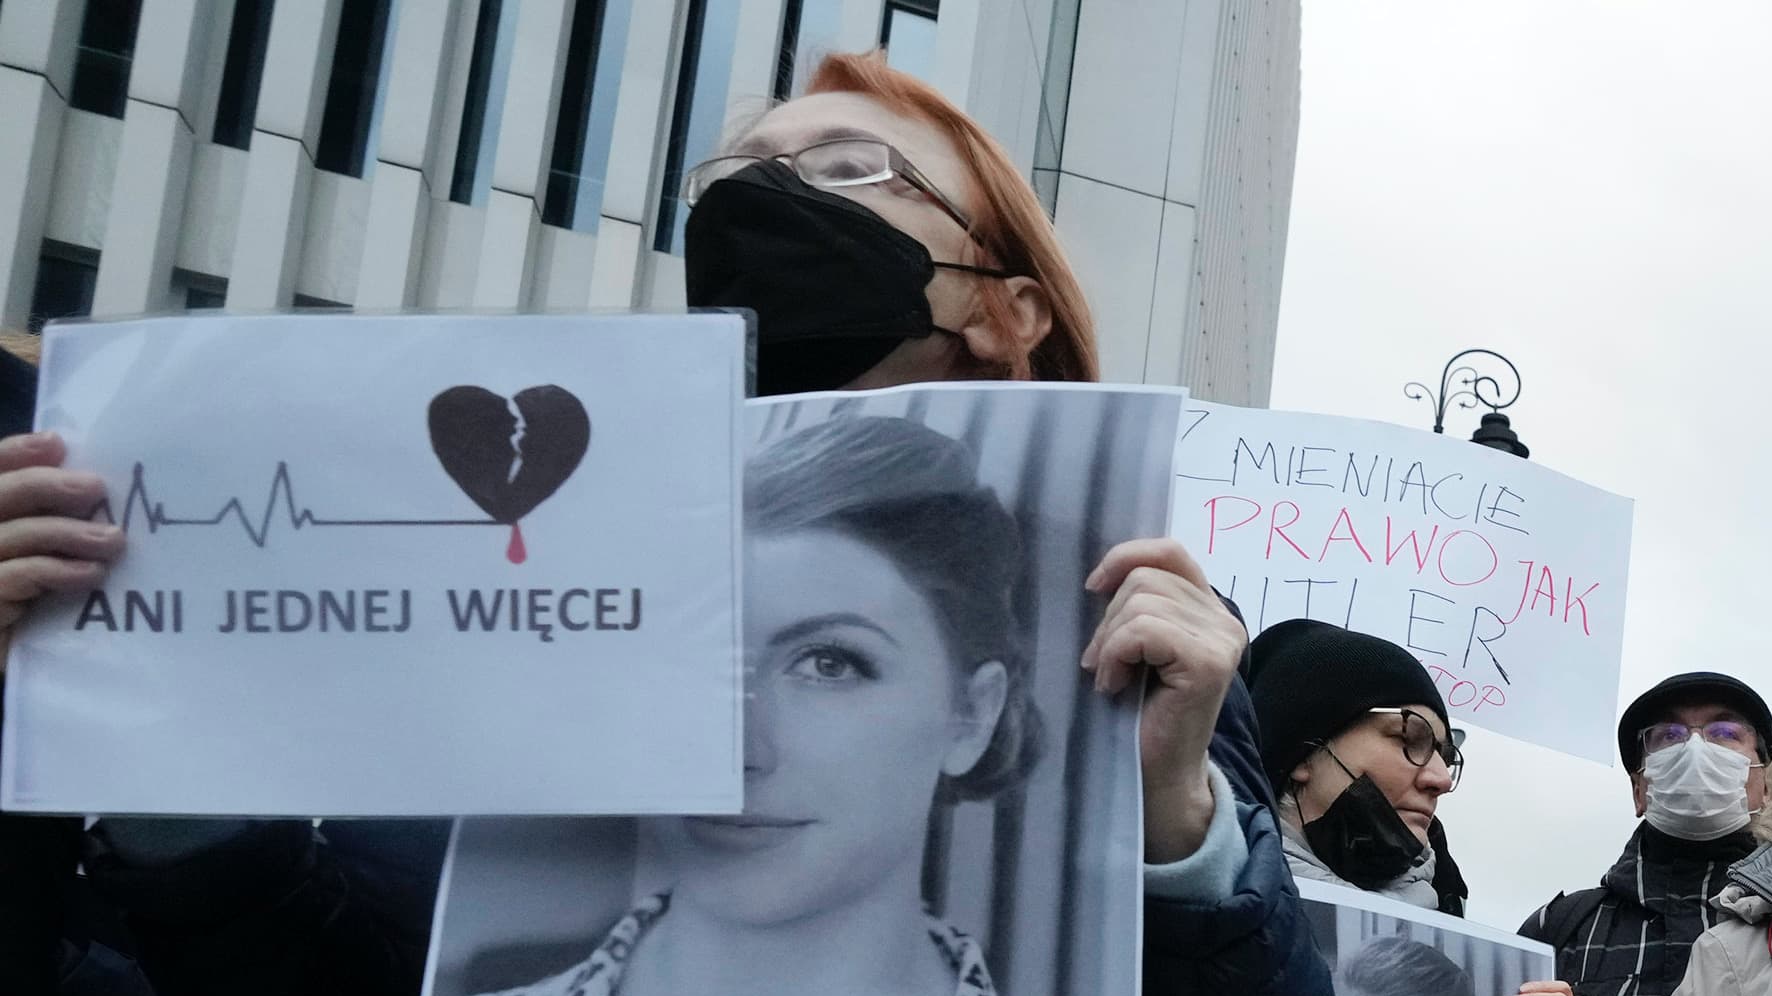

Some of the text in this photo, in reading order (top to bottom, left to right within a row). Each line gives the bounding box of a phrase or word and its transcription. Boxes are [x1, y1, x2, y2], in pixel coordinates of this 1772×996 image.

[1203, 495, 1600, 637] PRAWO JAK
[75, 587, 644, 643] ANI JEDNEJ WIĘCEJ
[1229, 575, 1511, 686] ITER
[1418, 658, 1507, 713] TOP
